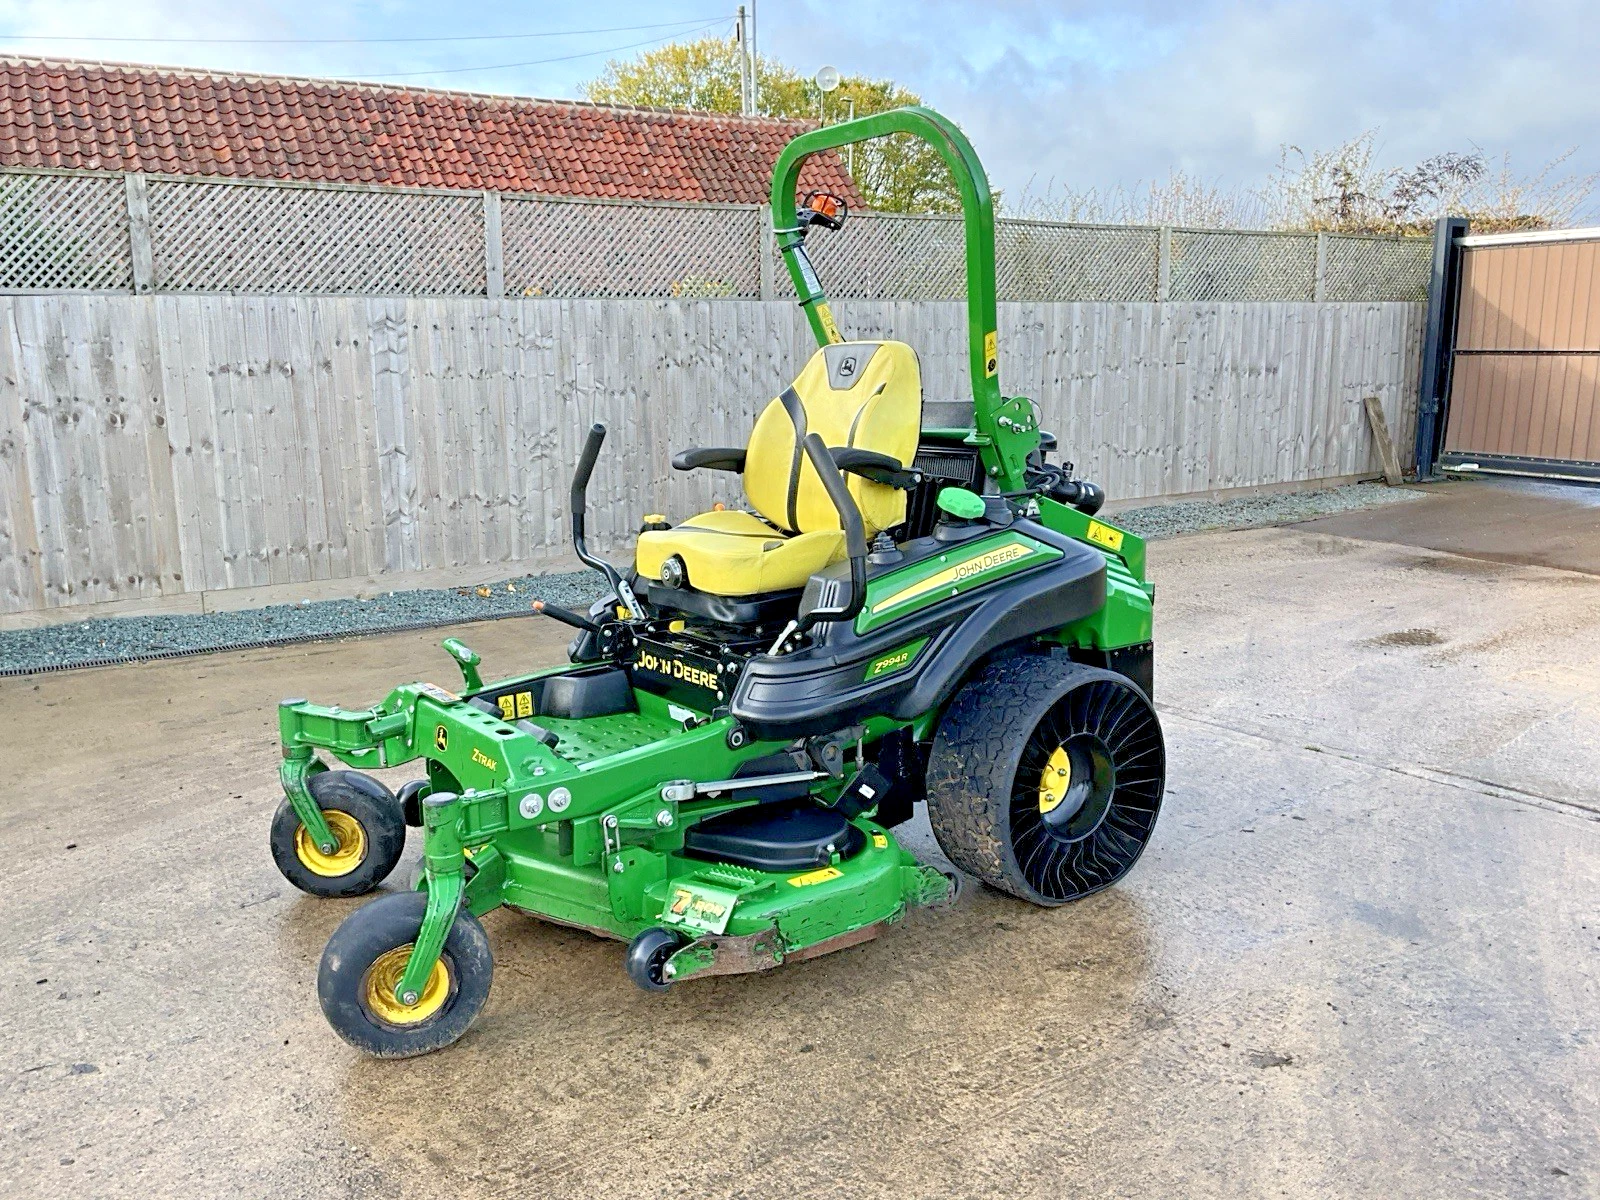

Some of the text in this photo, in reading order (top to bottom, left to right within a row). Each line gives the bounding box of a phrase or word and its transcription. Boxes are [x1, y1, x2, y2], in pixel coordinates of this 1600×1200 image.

[953, 547, 1020, 580] JOHN DEERE
[638, 650, 718, 691] JOHN DEERE
[471, 747, 498, 772] ZTRAK
[669, 888, 692, 916] 7
